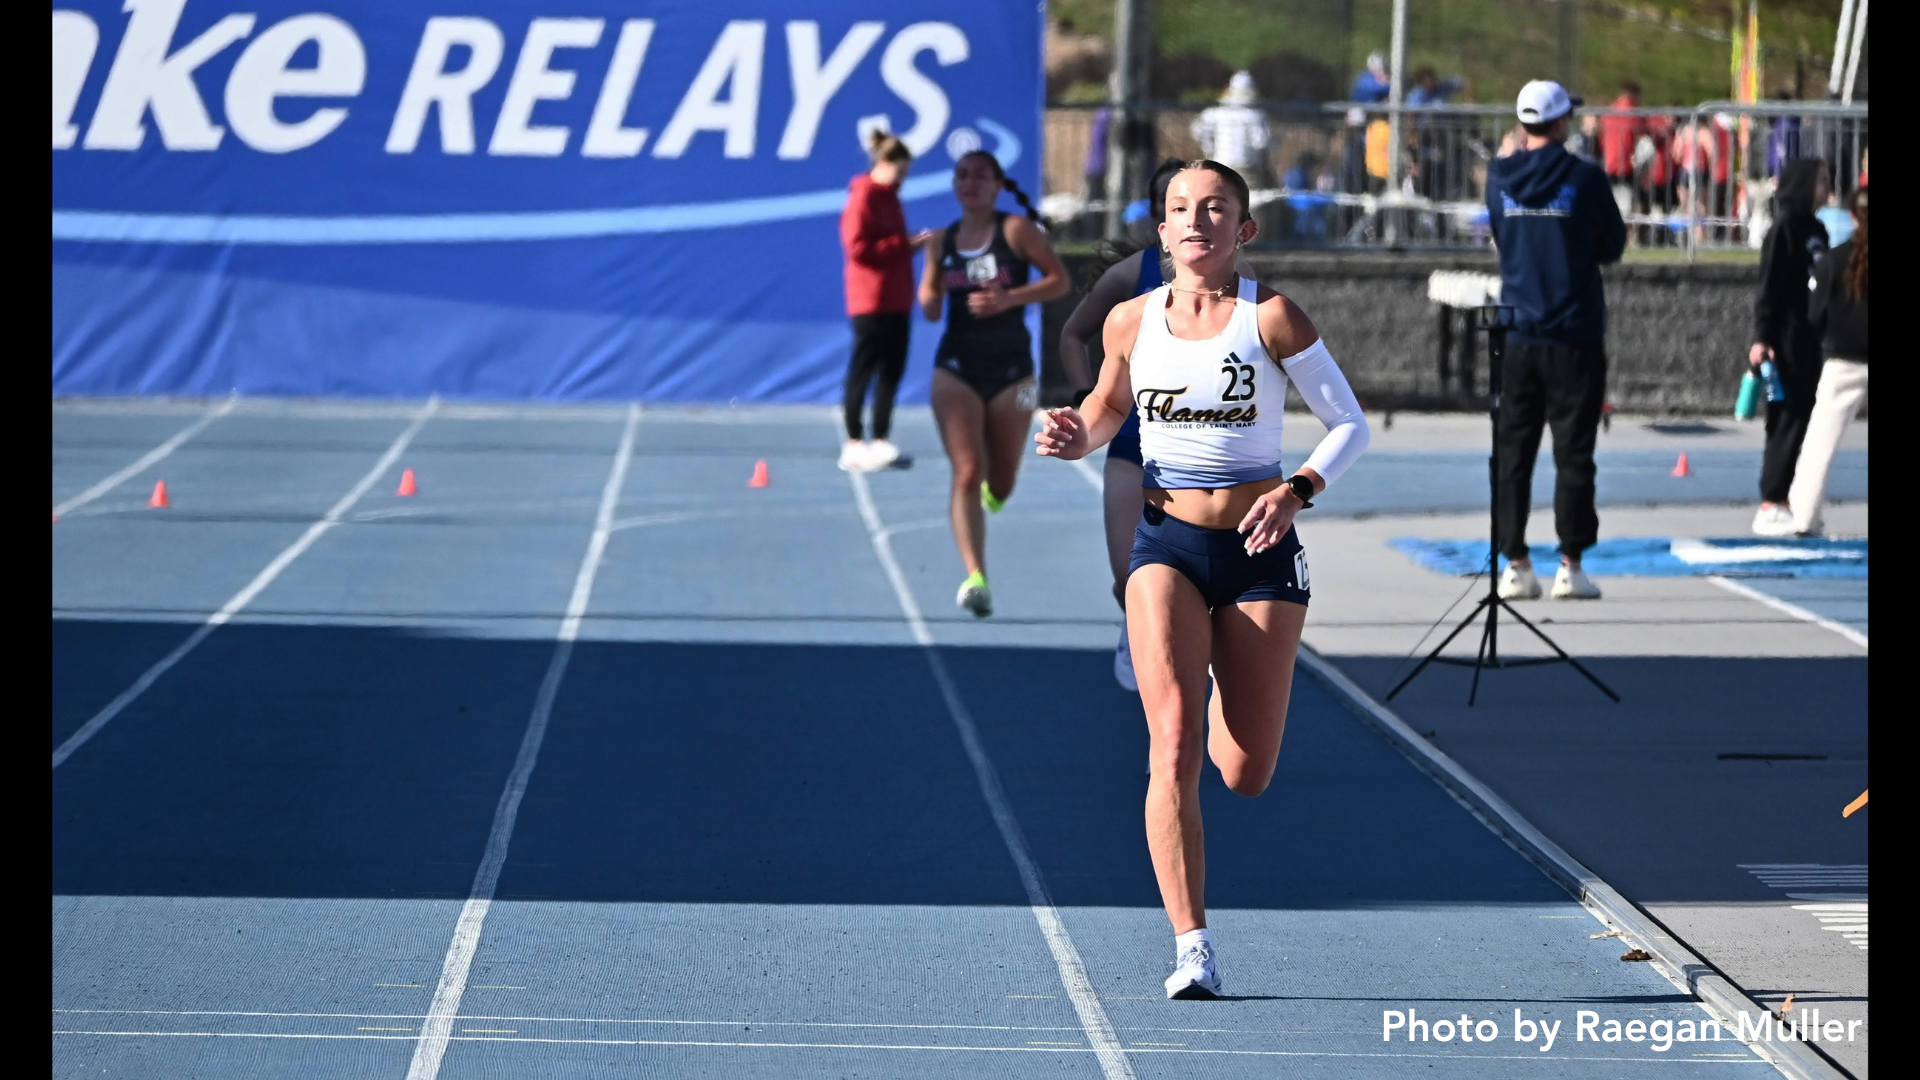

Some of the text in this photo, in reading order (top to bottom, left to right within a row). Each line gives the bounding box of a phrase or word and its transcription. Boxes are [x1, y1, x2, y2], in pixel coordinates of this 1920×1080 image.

[1221, 364, 1256, 402] 23
[1137, 385, 1259, 422] Flames
[1161, 422, 1193, 430] COLLEGE
